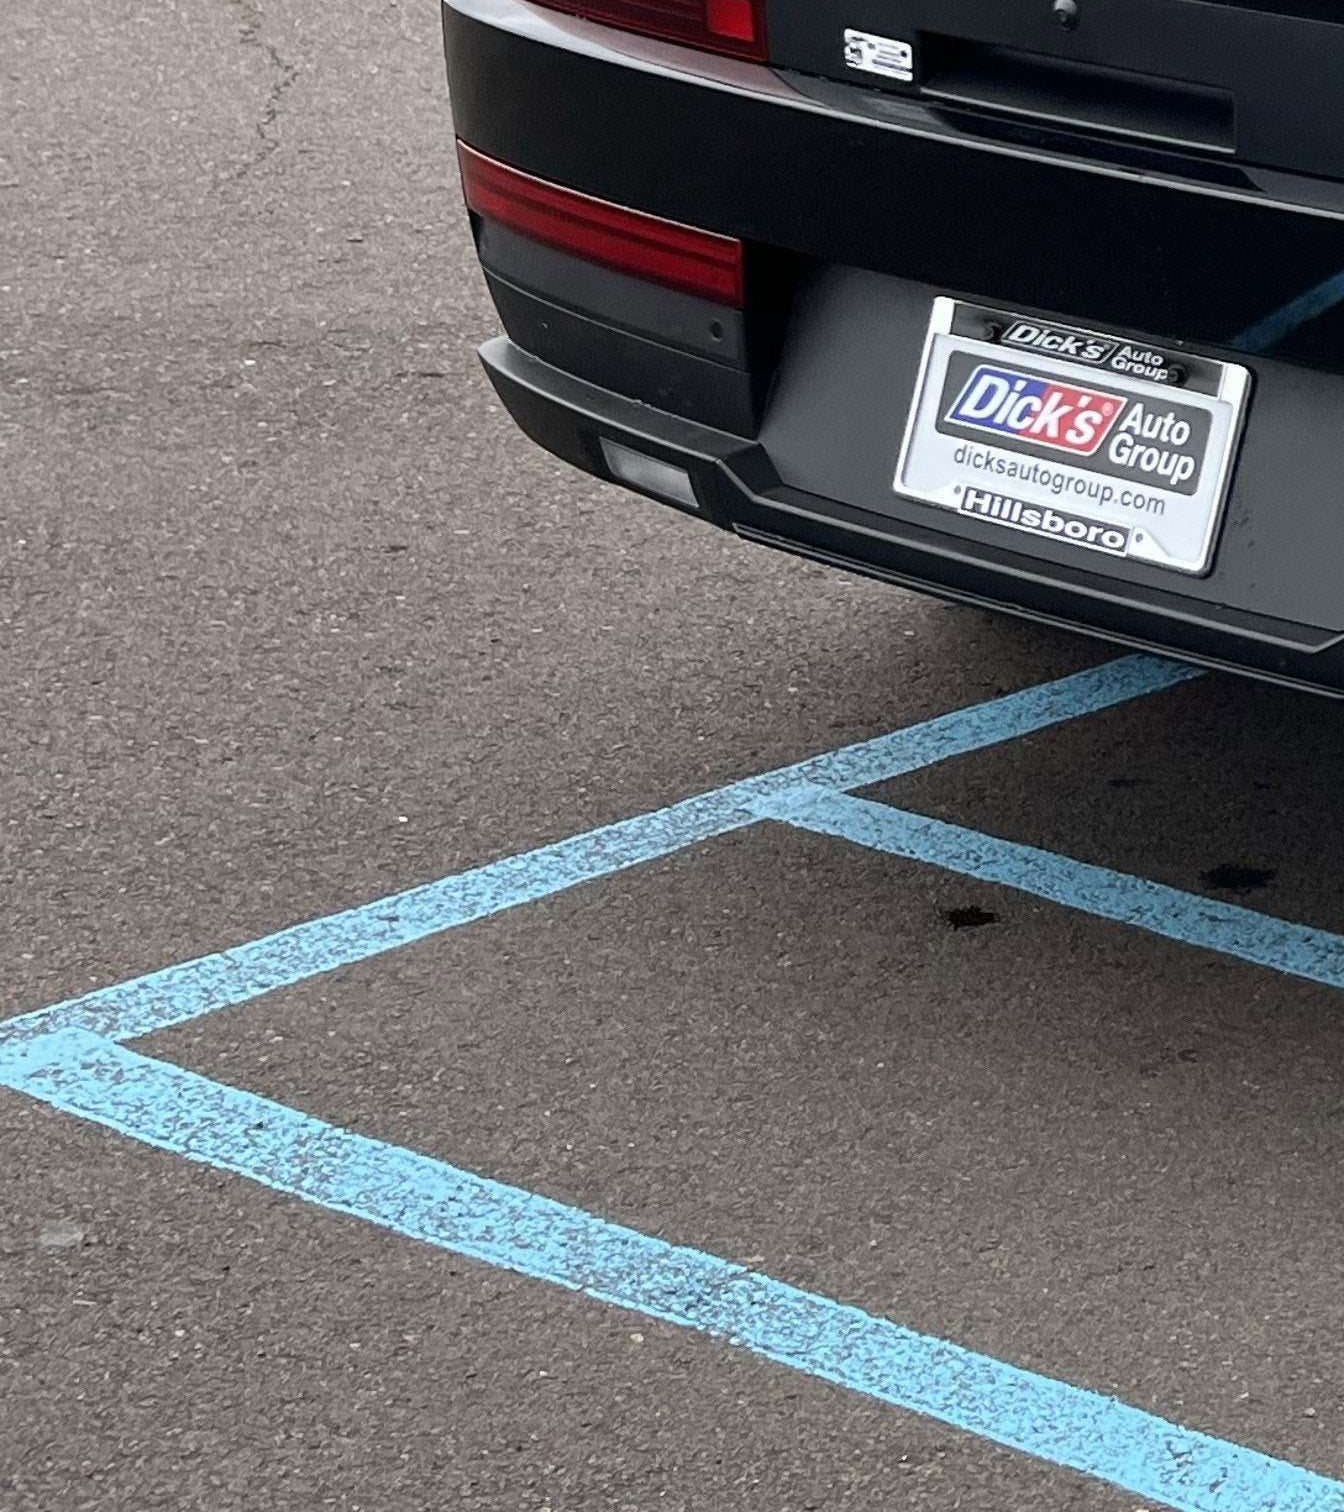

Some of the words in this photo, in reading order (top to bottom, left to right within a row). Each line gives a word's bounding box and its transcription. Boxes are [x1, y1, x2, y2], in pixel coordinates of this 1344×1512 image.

[1008, 324, 1105, 360] Dick's
[1118, 346, 1164, 366] Auto
[1112, 356, 1168, 381] Group
[959, 374, 1103, 445] Dick's
[1119, 403, 1190, 444] Auto
[954, 444, 1165, 515] dicksautogroup.com
[1110, 434, 1196, 486] Group
[964, 488, 1125, 549] Hillsboro
